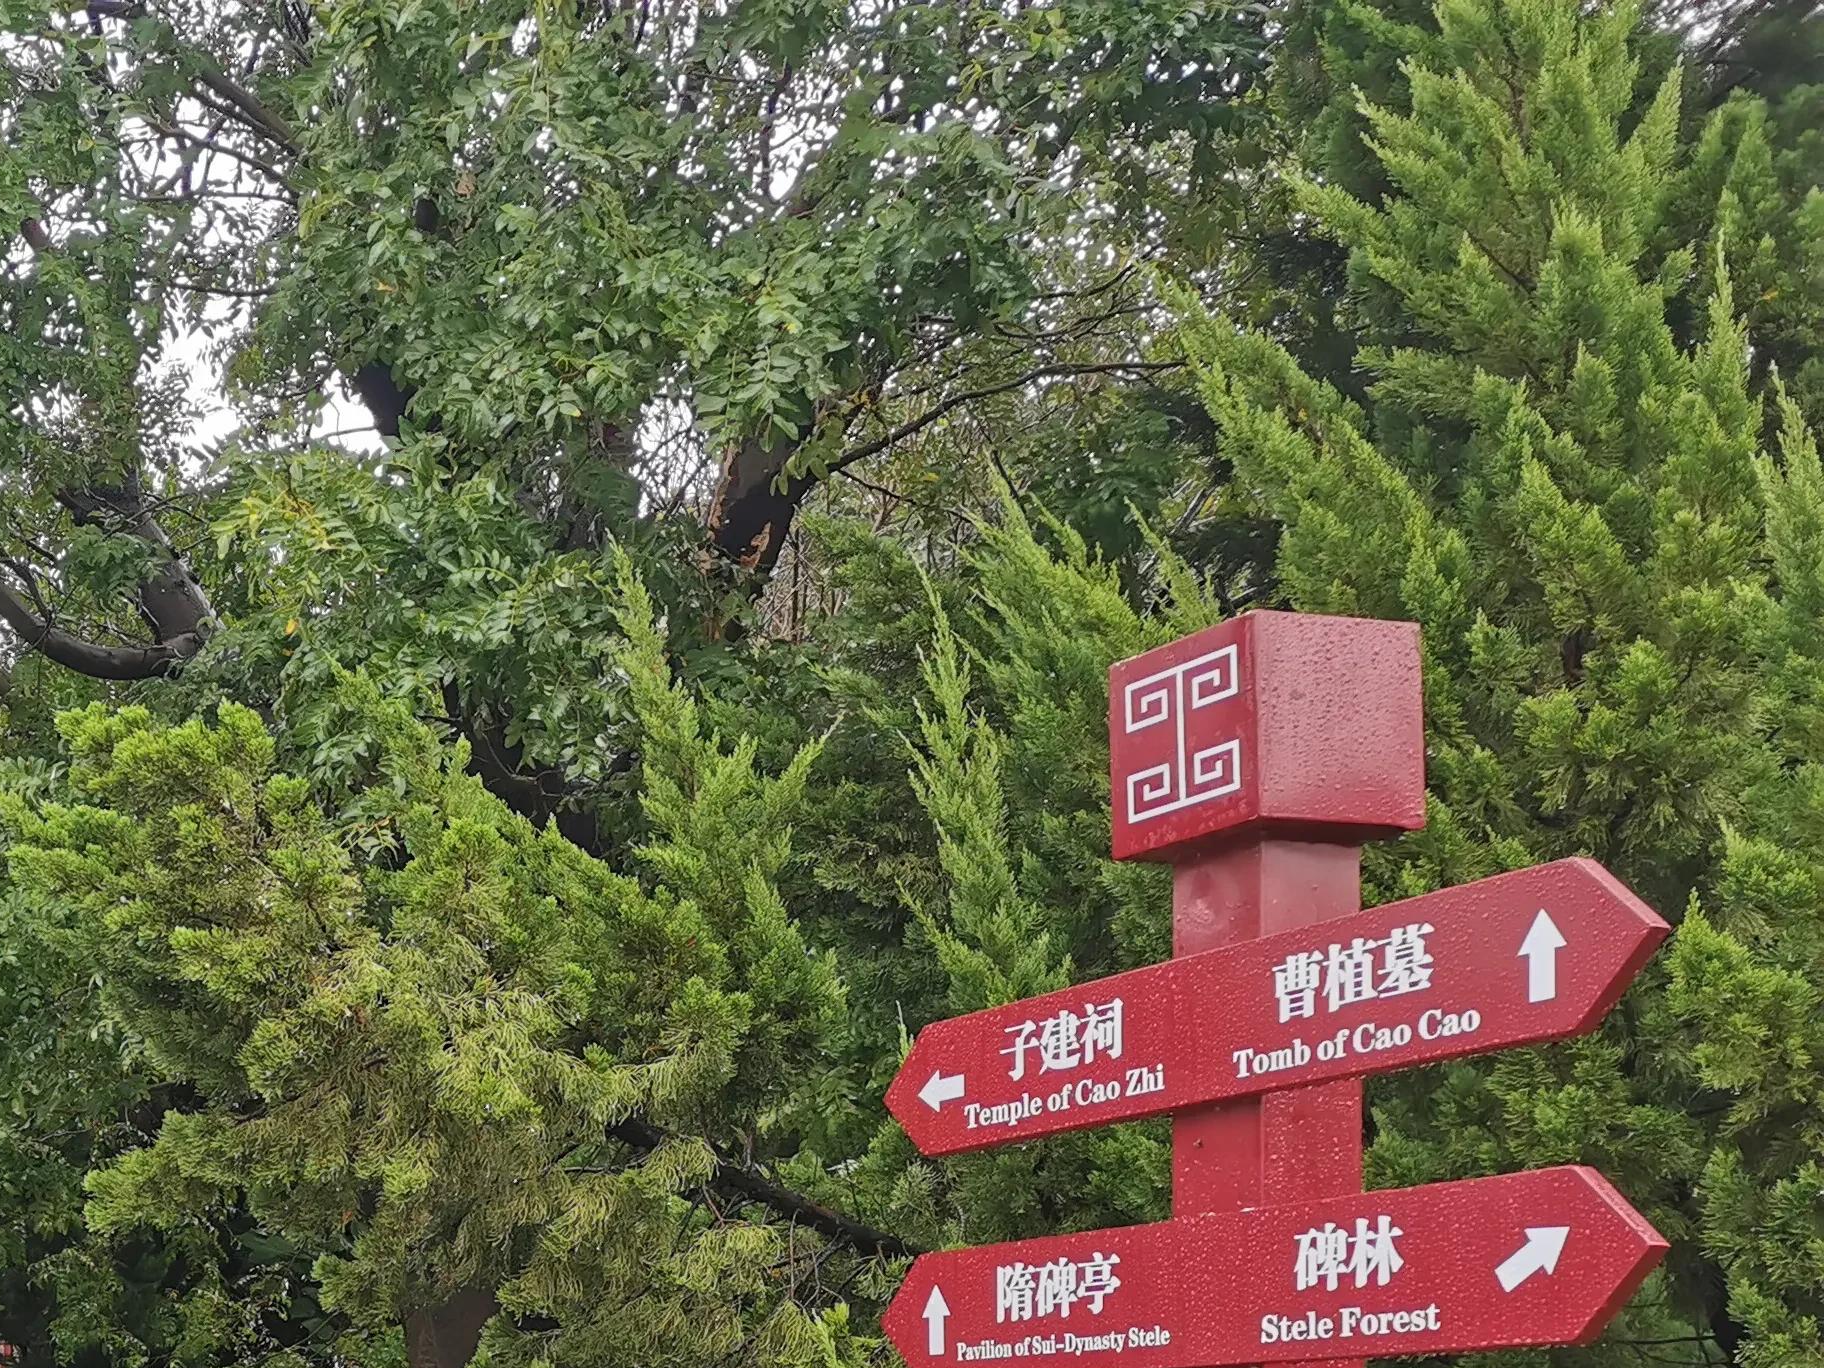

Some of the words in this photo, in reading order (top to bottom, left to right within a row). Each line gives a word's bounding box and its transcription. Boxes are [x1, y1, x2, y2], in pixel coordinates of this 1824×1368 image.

[1271, 922, 1435, 1024] 曹植墓
[999, 997, 1124, 1082] 子建祠
[1232, 1038, 1312, 1079] Tomb
[1316, 1028, 1351, 1062] of
[1352, 1022, 1413, 1054] Cao
[1417, 1008, 1482, 1041] Cao
[963, 1092, 1043, 1130] Temple
[1046, 1083, 1073, 1112] of
[1074, 1078, 1121, 1107] Cao
[1125, 1063, 1166, 1097] Zhi
[996, 1251, 1122, 1324] 隋碑亭
[1293, 1214, 1405, 1292] 碑林
[956, 1338, 1013, 1362] Pavilion
[1014, 1336, 1032, 1357] of
[1031, 1330, 1127, 1357] Sui-Dynasty
[1128, 1325, 1171, 1349] Stele
[1260, 1310, 1334, 1344] Stele
[1338, 1302, 1442, 1338] Forest
